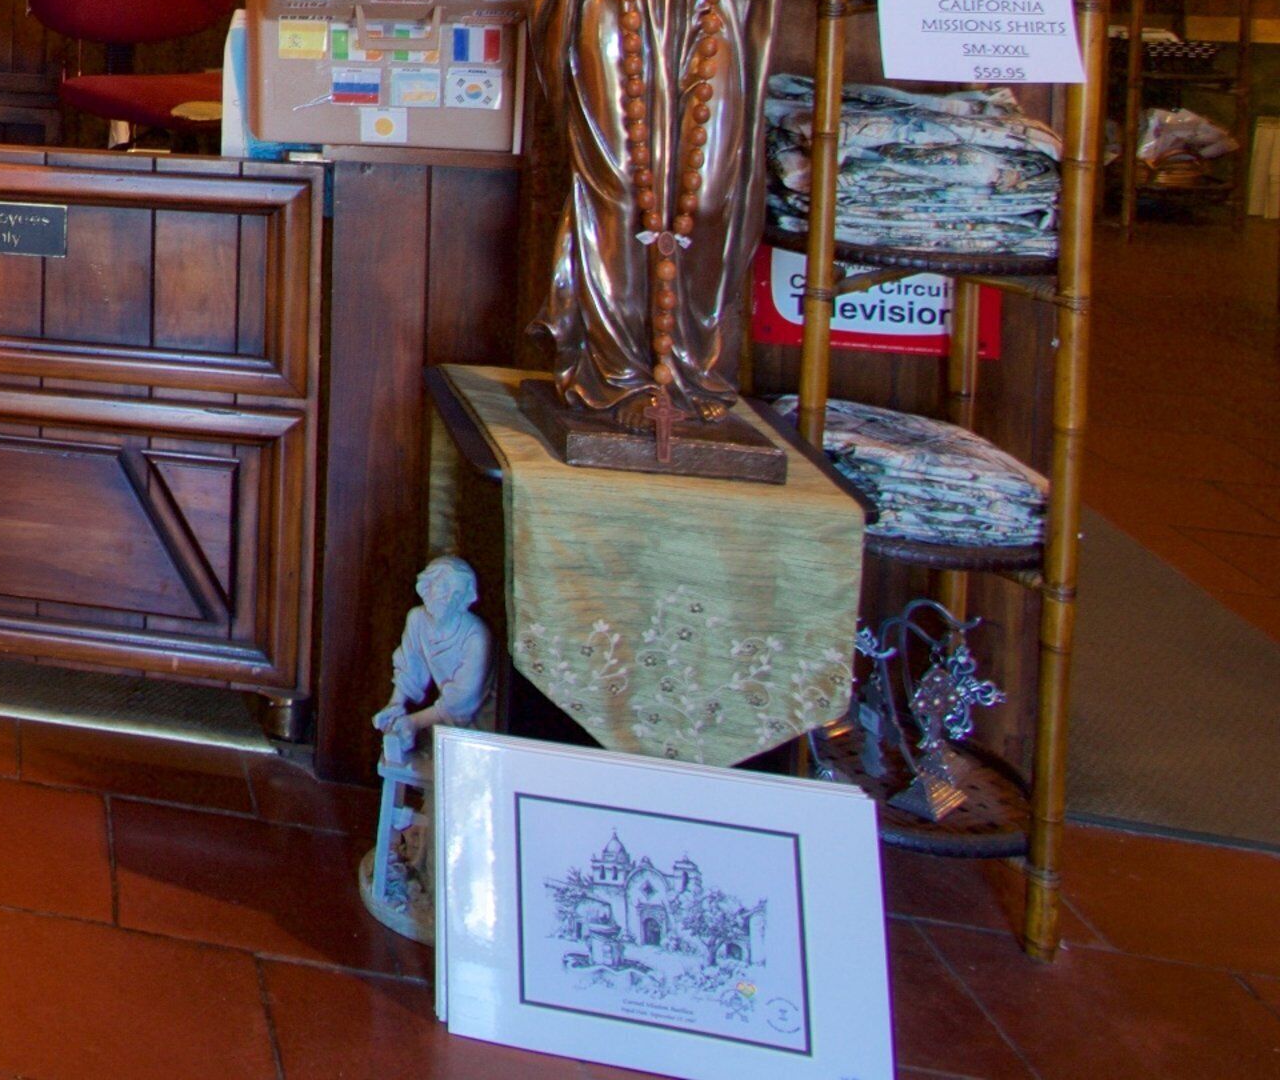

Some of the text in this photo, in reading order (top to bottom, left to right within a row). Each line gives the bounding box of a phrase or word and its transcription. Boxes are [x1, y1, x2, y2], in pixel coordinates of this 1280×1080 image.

[938, 0, 1044, 13] CALIFORNIA
[921, 19, 1067, 35] MISSIONS SHIRTS
[962, 43, 1030, 56] SM-XXXL
[974, 66, 1025, 80] $59.95
[879, 281, 953, 298] Circui
